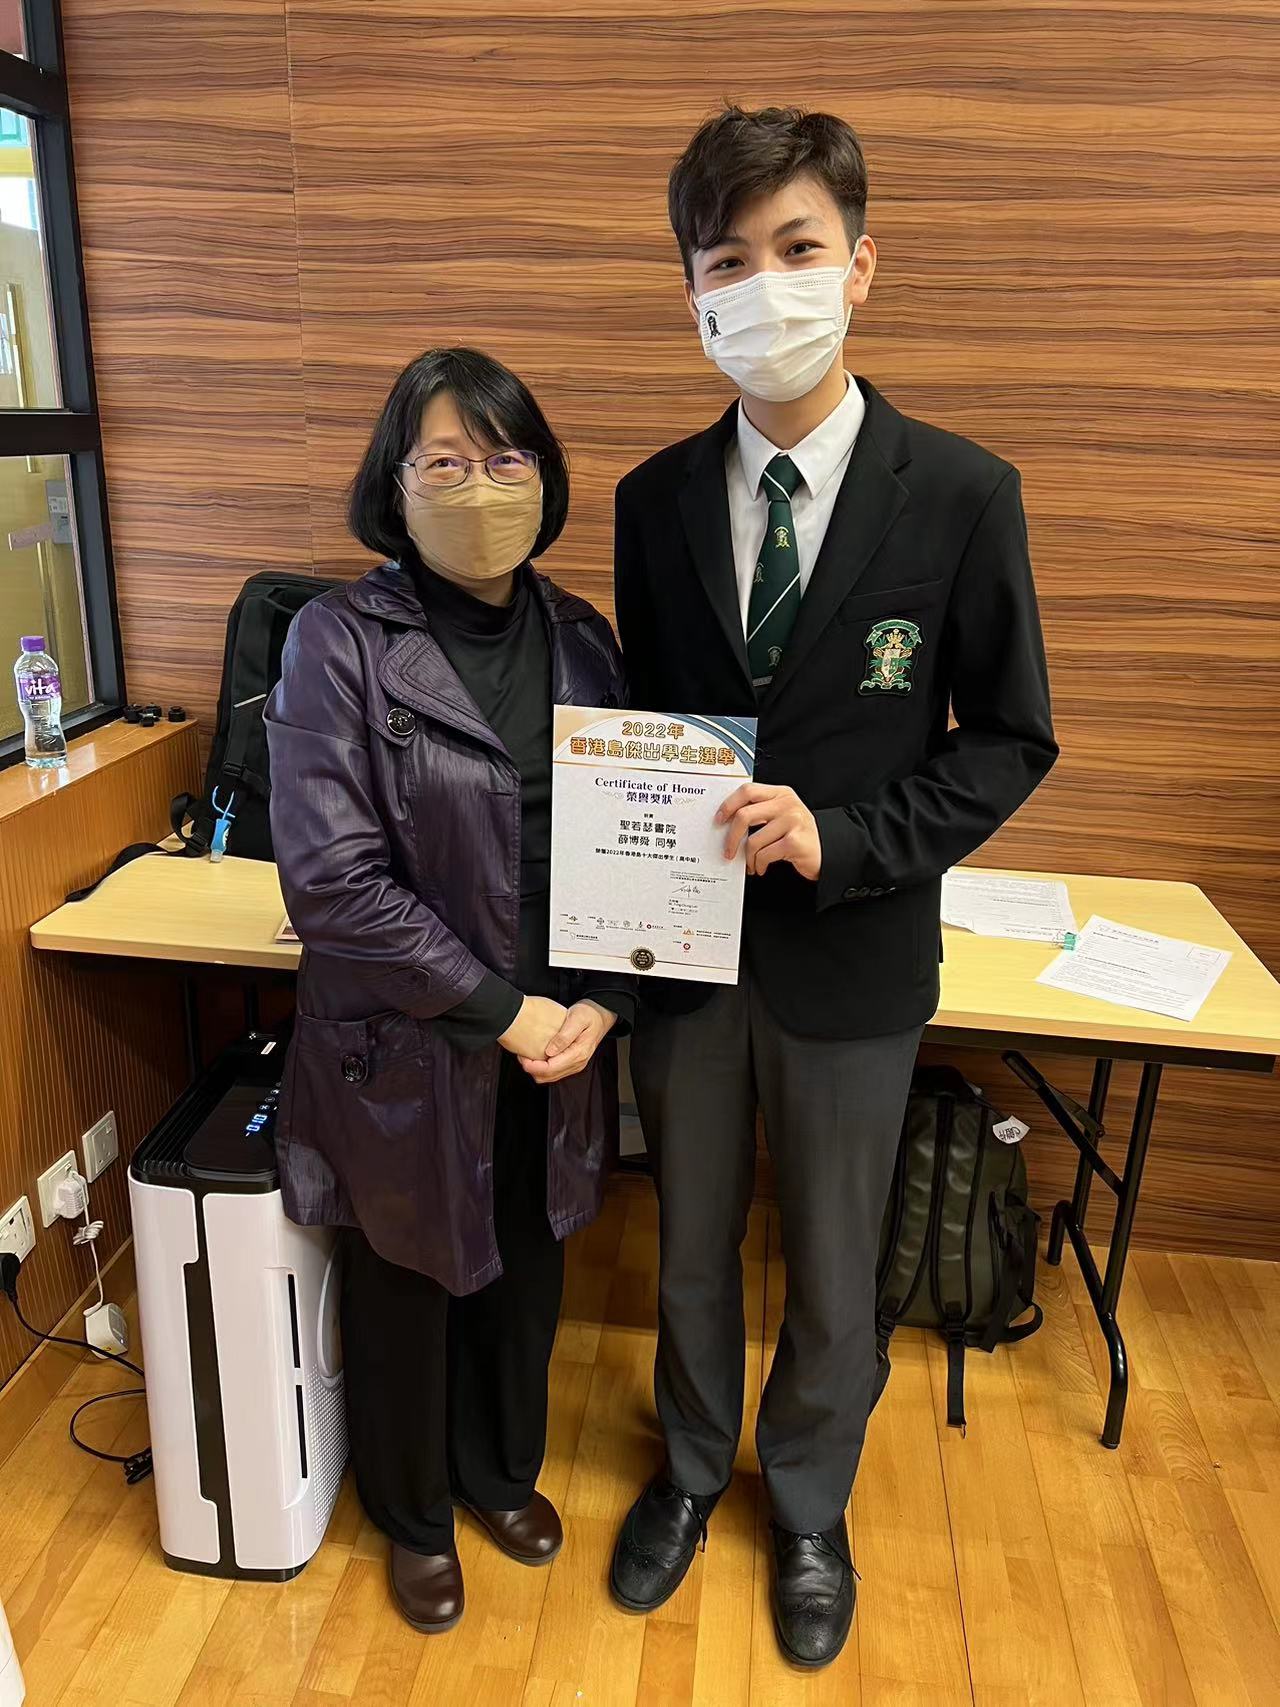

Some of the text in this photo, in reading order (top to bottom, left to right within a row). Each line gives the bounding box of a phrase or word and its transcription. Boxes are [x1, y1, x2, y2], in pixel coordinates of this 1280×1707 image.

[25, 678, 56, 695] vita
[622, 721, 685, 739] 2022年
[570, 736, 736, 765] 香港島傑出學生選舉
[595, 777, 707, 795] Certificate of Honor
[620, 820, 676, 834] 聖若瑟書院
[655, 837, 676, 849] 同學
